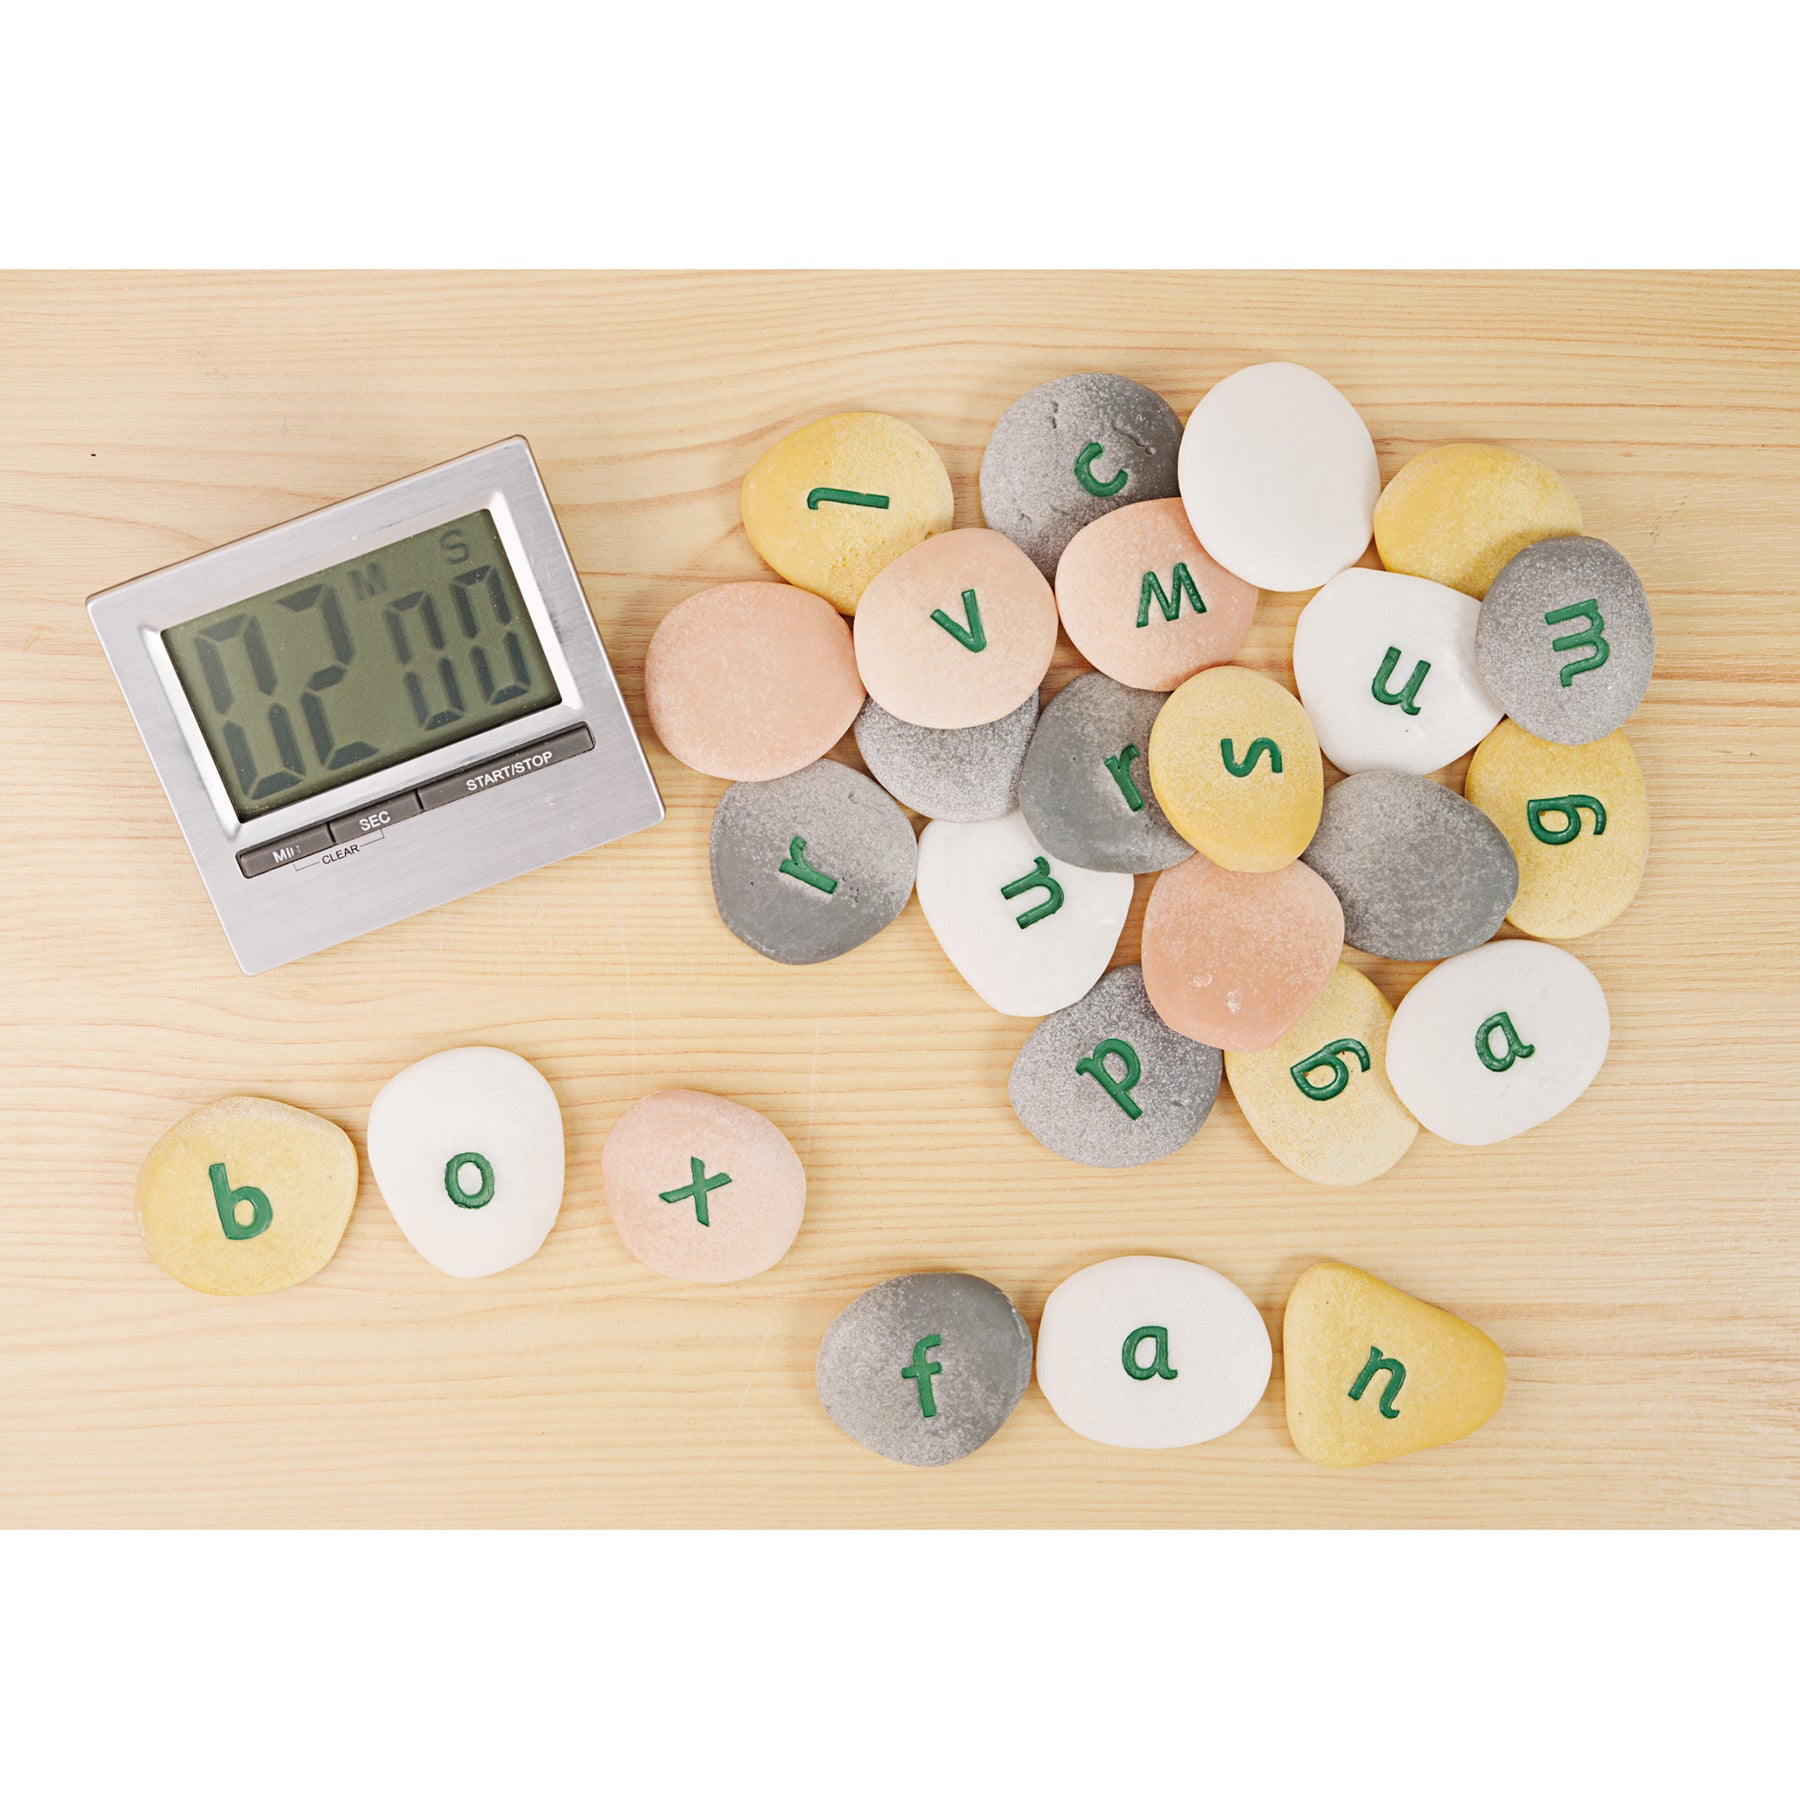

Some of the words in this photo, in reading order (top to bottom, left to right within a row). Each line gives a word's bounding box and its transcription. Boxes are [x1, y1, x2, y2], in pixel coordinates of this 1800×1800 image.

[1074, 441, 1129, 498] c
[440, 528, 471, 565] S
[1544, 598, 1610, 688] m
[1371, 646, 1431, 716] u
[464, 750, 554, 792] START/STOP
[1103, 744, 1145, 812] r
[359, 810, 392, 832] SEC
[321, 844, 361, 866] CLEAR
[778, 836, 838, 895] r
[1475, 1011, 1535, 1073] a
[1075, 1038, 1143, 1121] p
